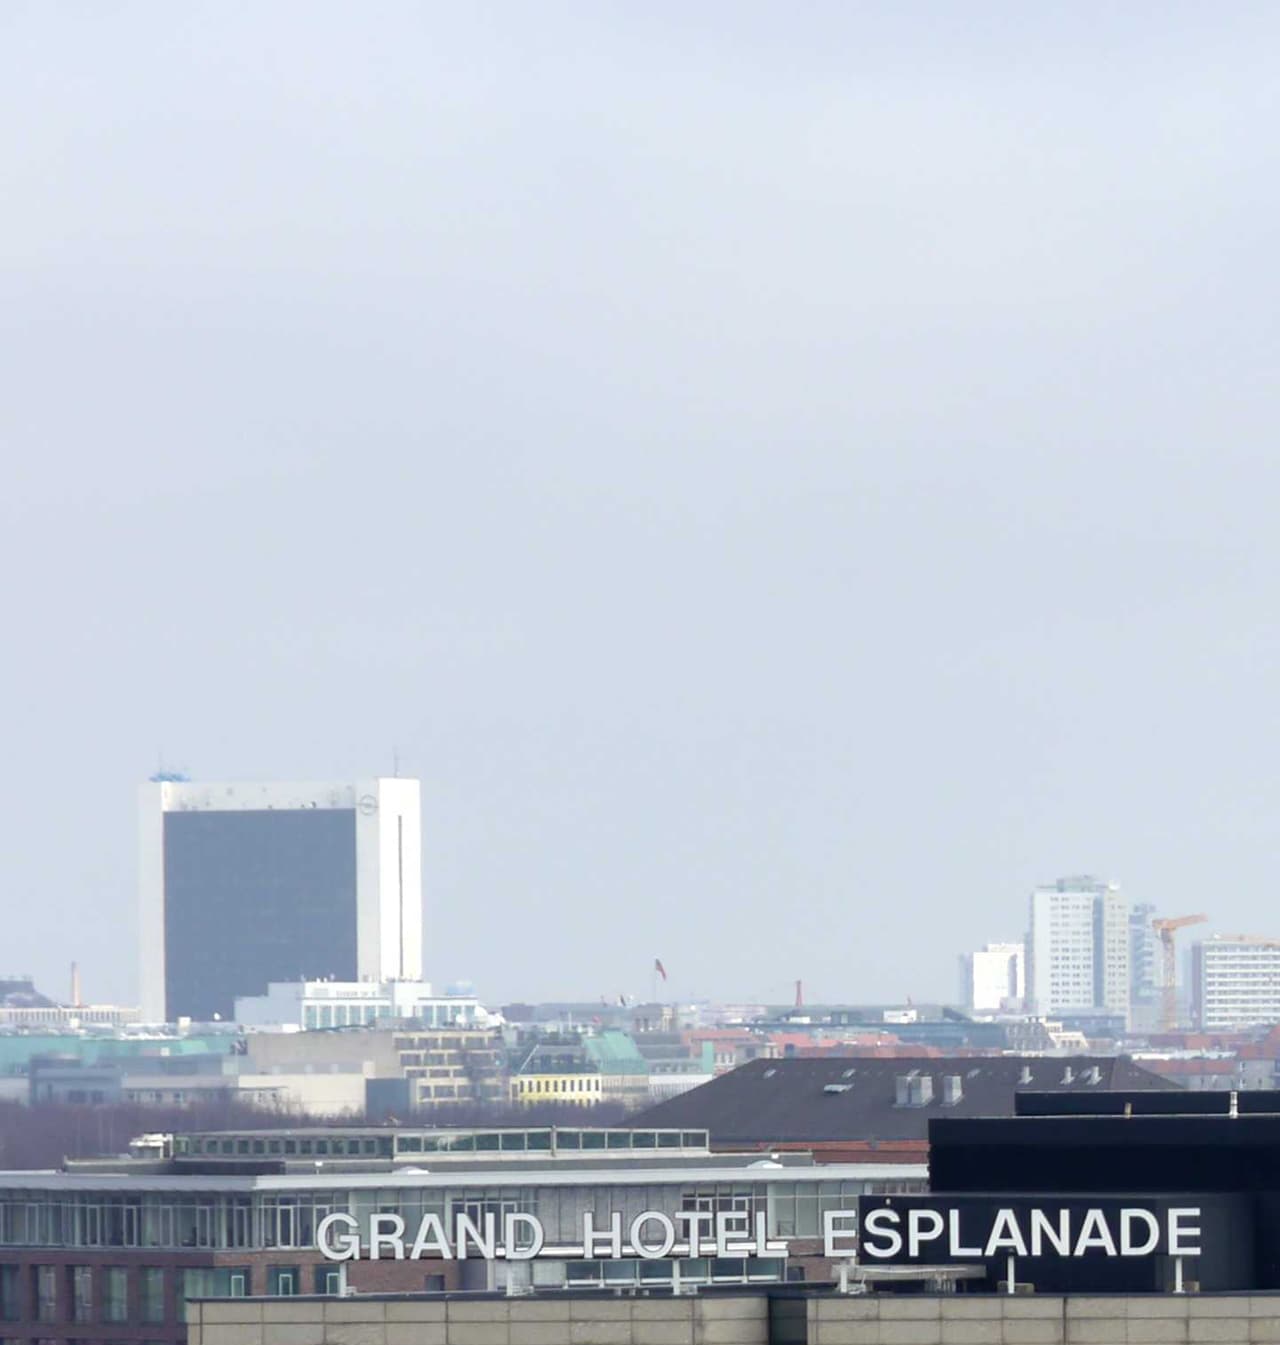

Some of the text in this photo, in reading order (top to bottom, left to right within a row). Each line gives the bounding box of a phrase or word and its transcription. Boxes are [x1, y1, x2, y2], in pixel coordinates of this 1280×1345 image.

[316, 1207, 1201, 1260] GRAND HOTEL ESPLANADE
